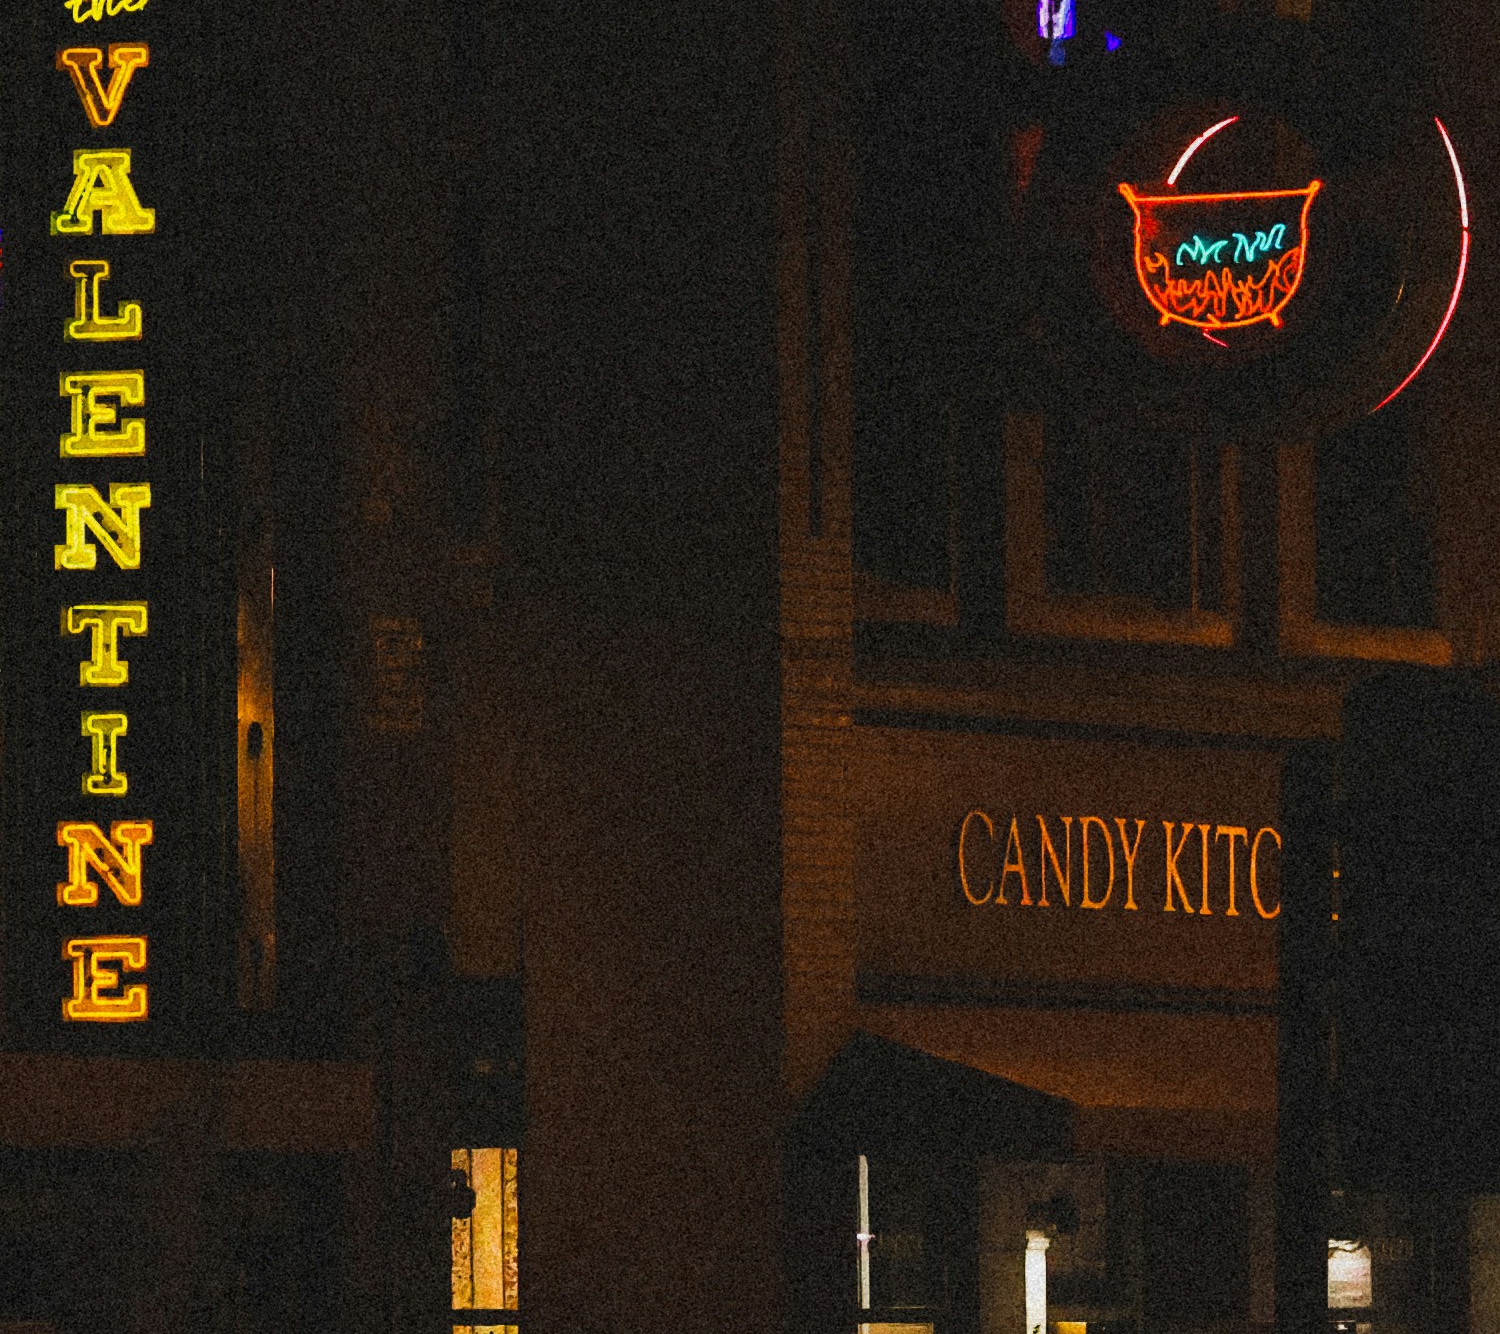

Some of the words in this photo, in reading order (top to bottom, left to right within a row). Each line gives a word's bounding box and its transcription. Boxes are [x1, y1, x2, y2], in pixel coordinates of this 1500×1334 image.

[49, 42, 156, 1022] VALENTINE
[956, 808, 1147, 912] CANDY
[1161, 818, 1284, 921] KITC
